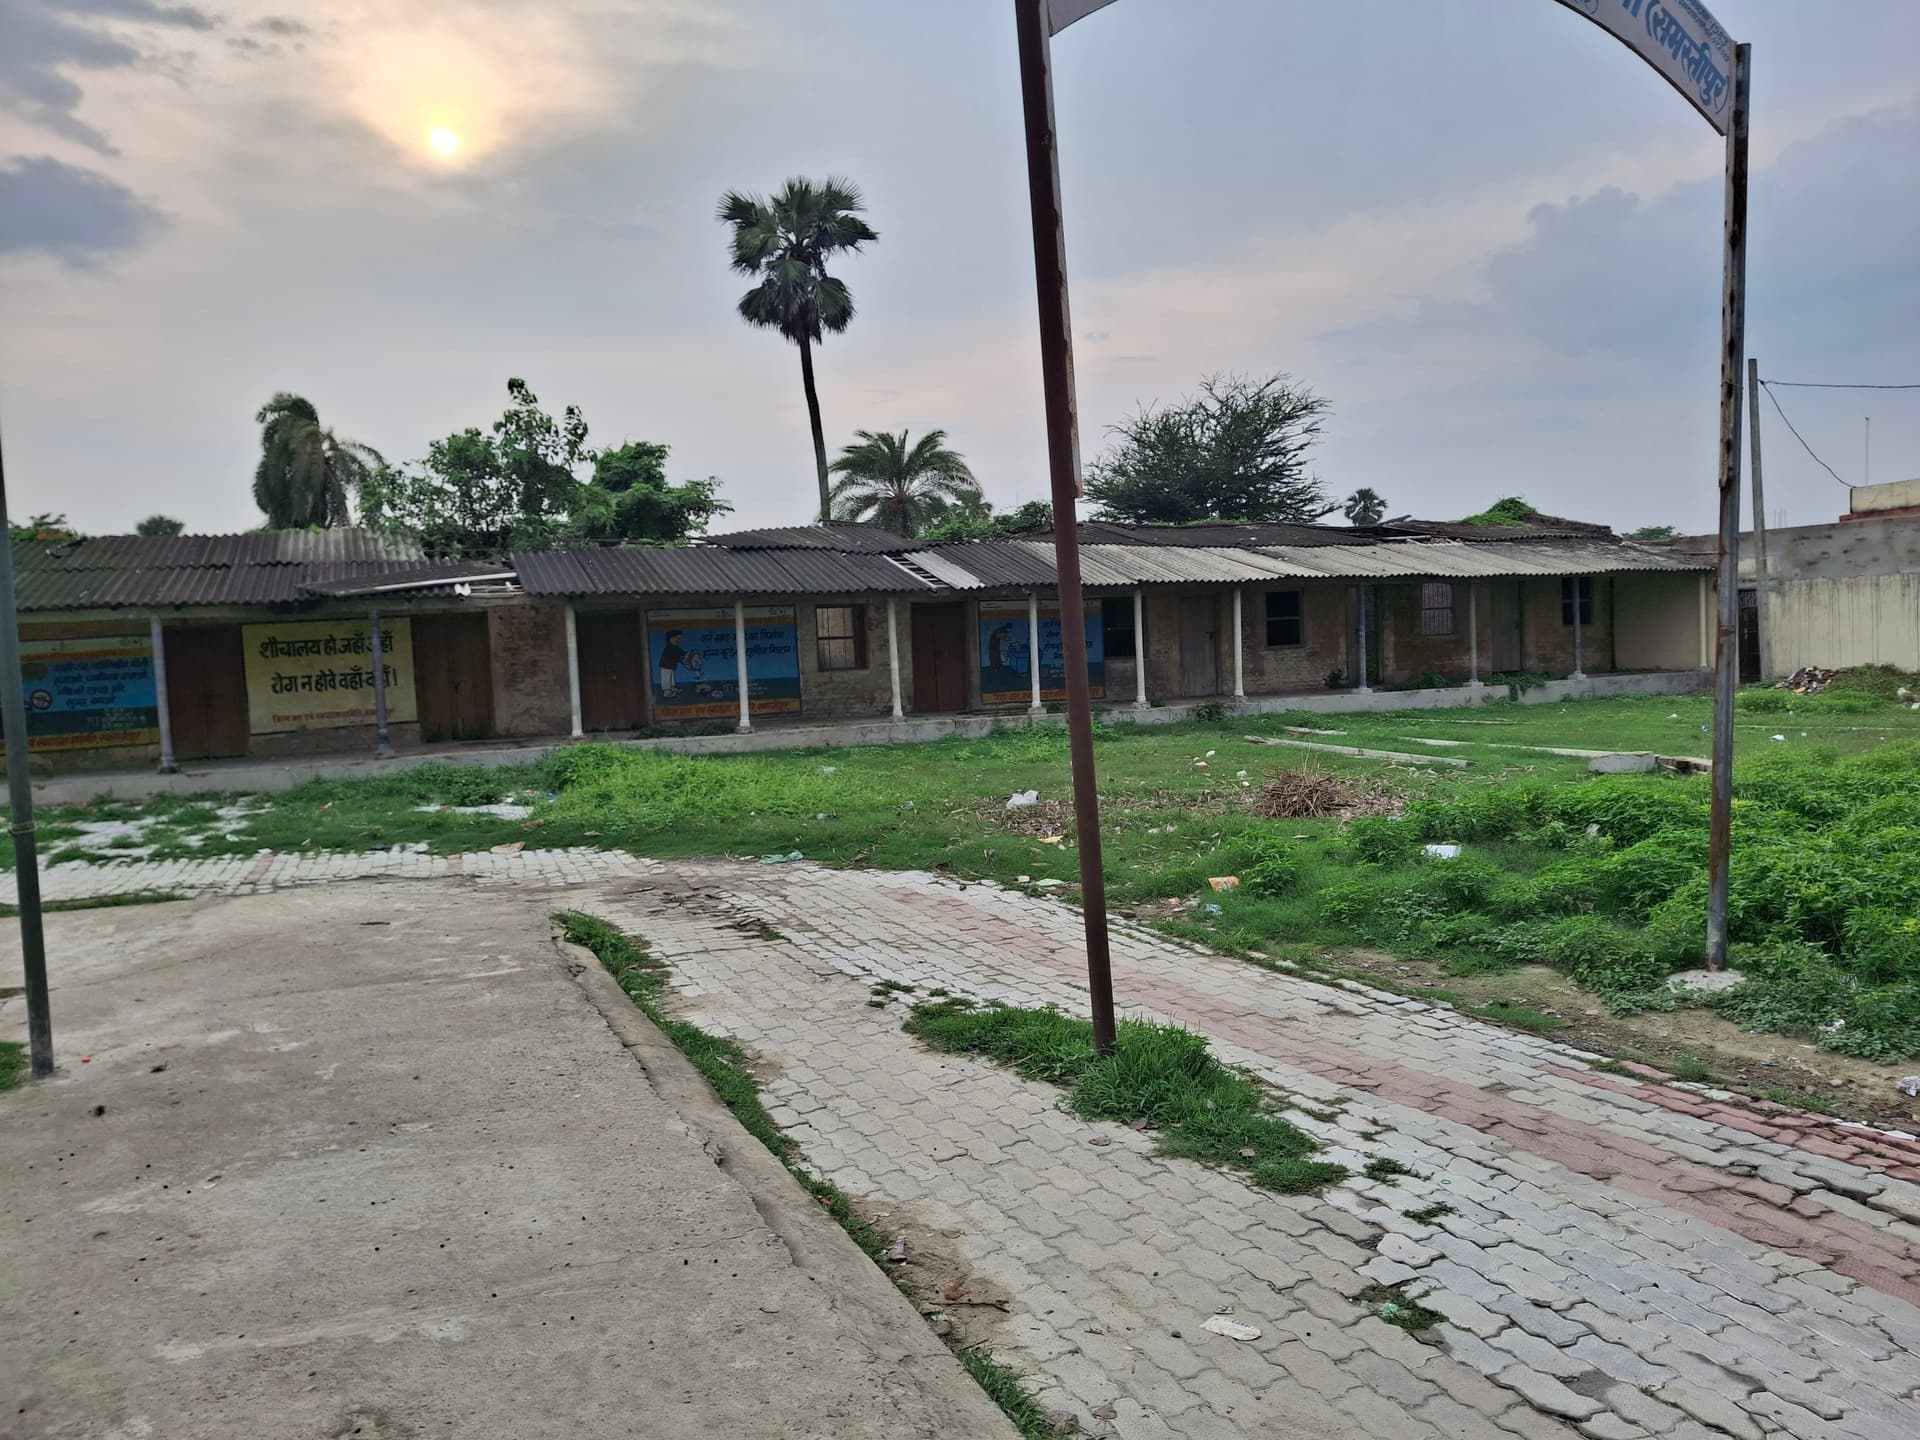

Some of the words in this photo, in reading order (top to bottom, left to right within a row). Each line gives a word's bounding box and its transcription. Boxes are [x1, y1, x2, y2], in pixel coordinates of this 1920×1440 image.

[259, 636, 322, 658] शौचालय
[324, 634, 337, 655] हो
[338, 630, 365, 655] जहाँ
[271, 671, 298, 694] रोग
[301, 675, 313, 692] न
[315, 669, 337, 692] होवे
